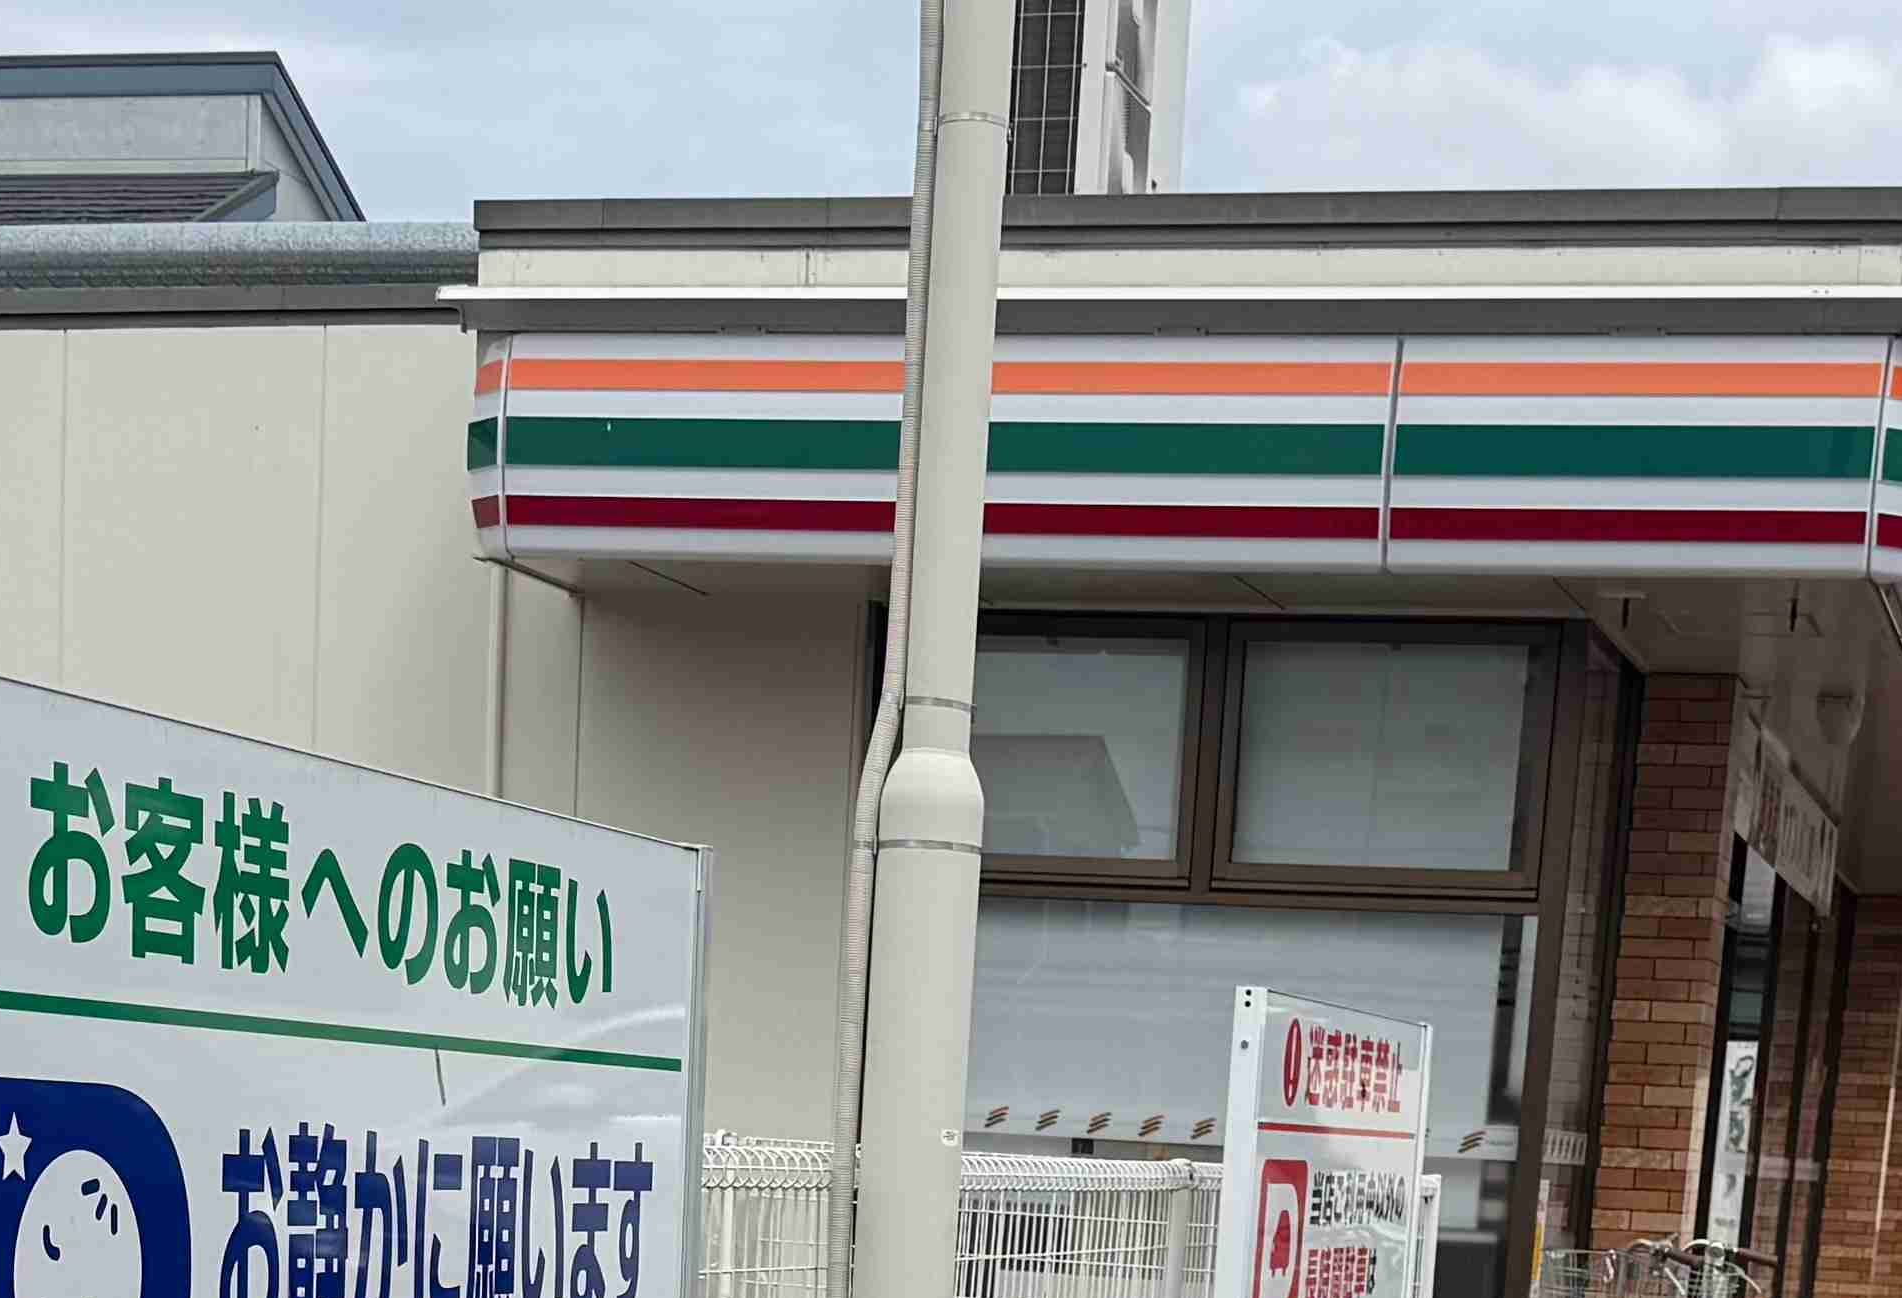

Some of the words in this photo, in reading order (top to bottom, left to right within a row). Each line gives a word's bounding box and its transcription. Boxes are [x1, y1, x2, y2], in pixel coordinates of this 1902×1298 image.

[27, 760, 614, 1008] お客様へのお願い
[1304, 1023, 1405, 1115] 迷惑駐車禁止
[1309, 1171, 1406, 1226] 当店ご利用中以外の
